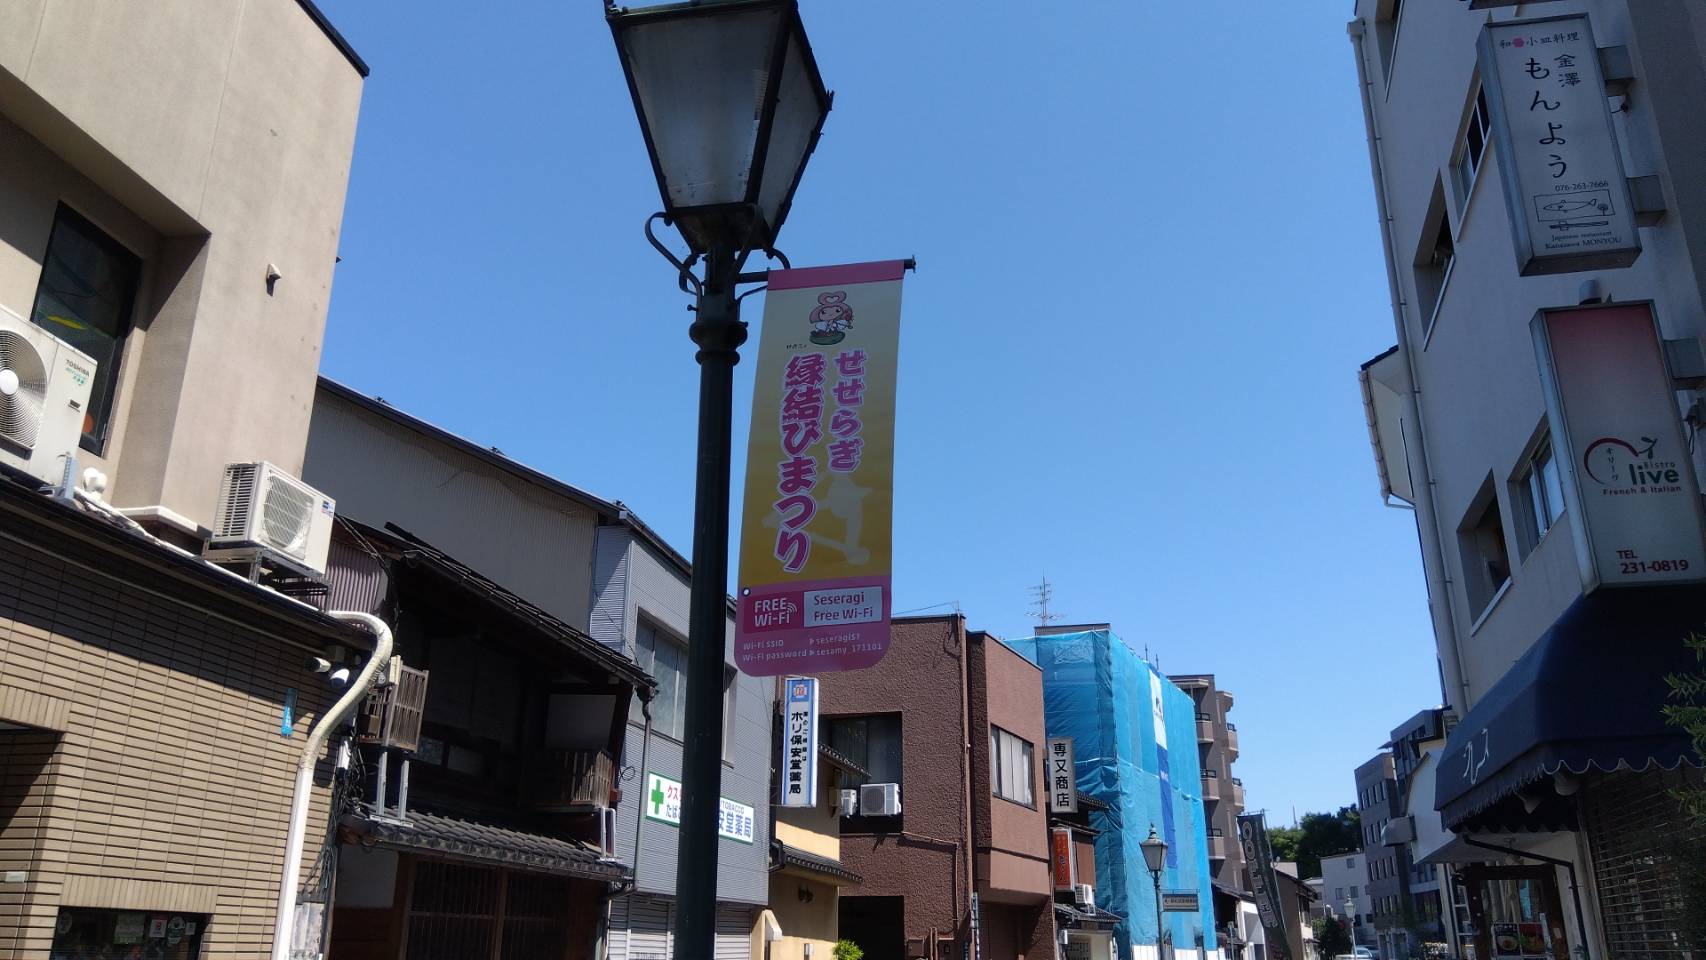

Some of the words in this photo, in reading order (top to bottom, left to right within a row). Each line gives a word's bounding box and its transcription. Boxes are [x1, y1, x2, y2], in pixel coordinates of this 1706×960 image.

[1525, 57, 1567, 178] もんよう
[1555, 181, 1609, 191] 076-263-7666
[828, 349, 867, 471] せせらぎ
[774, 352, 825, 573] 縁結びまつり
[1602, 488, 1637, 496] French
[1617, 550, 1638, 560] TEL
[1620, 559, 1688, 574] 231-0819
[754, 597, 787, 613] FREE
[814, 592, 865, 606] Seseragi
[754, 611, 790, 627] Wi-Fi
[814, 610, 839, 621] Free
[842, 607, 873, 619] Wi-Fi
[766, 640, 784, 648] SSID
[742, 652, 764, 661] Wi-Fi
[766, 649, 807, 661] password
[1053, 743, 1070, 807] 専又商店
